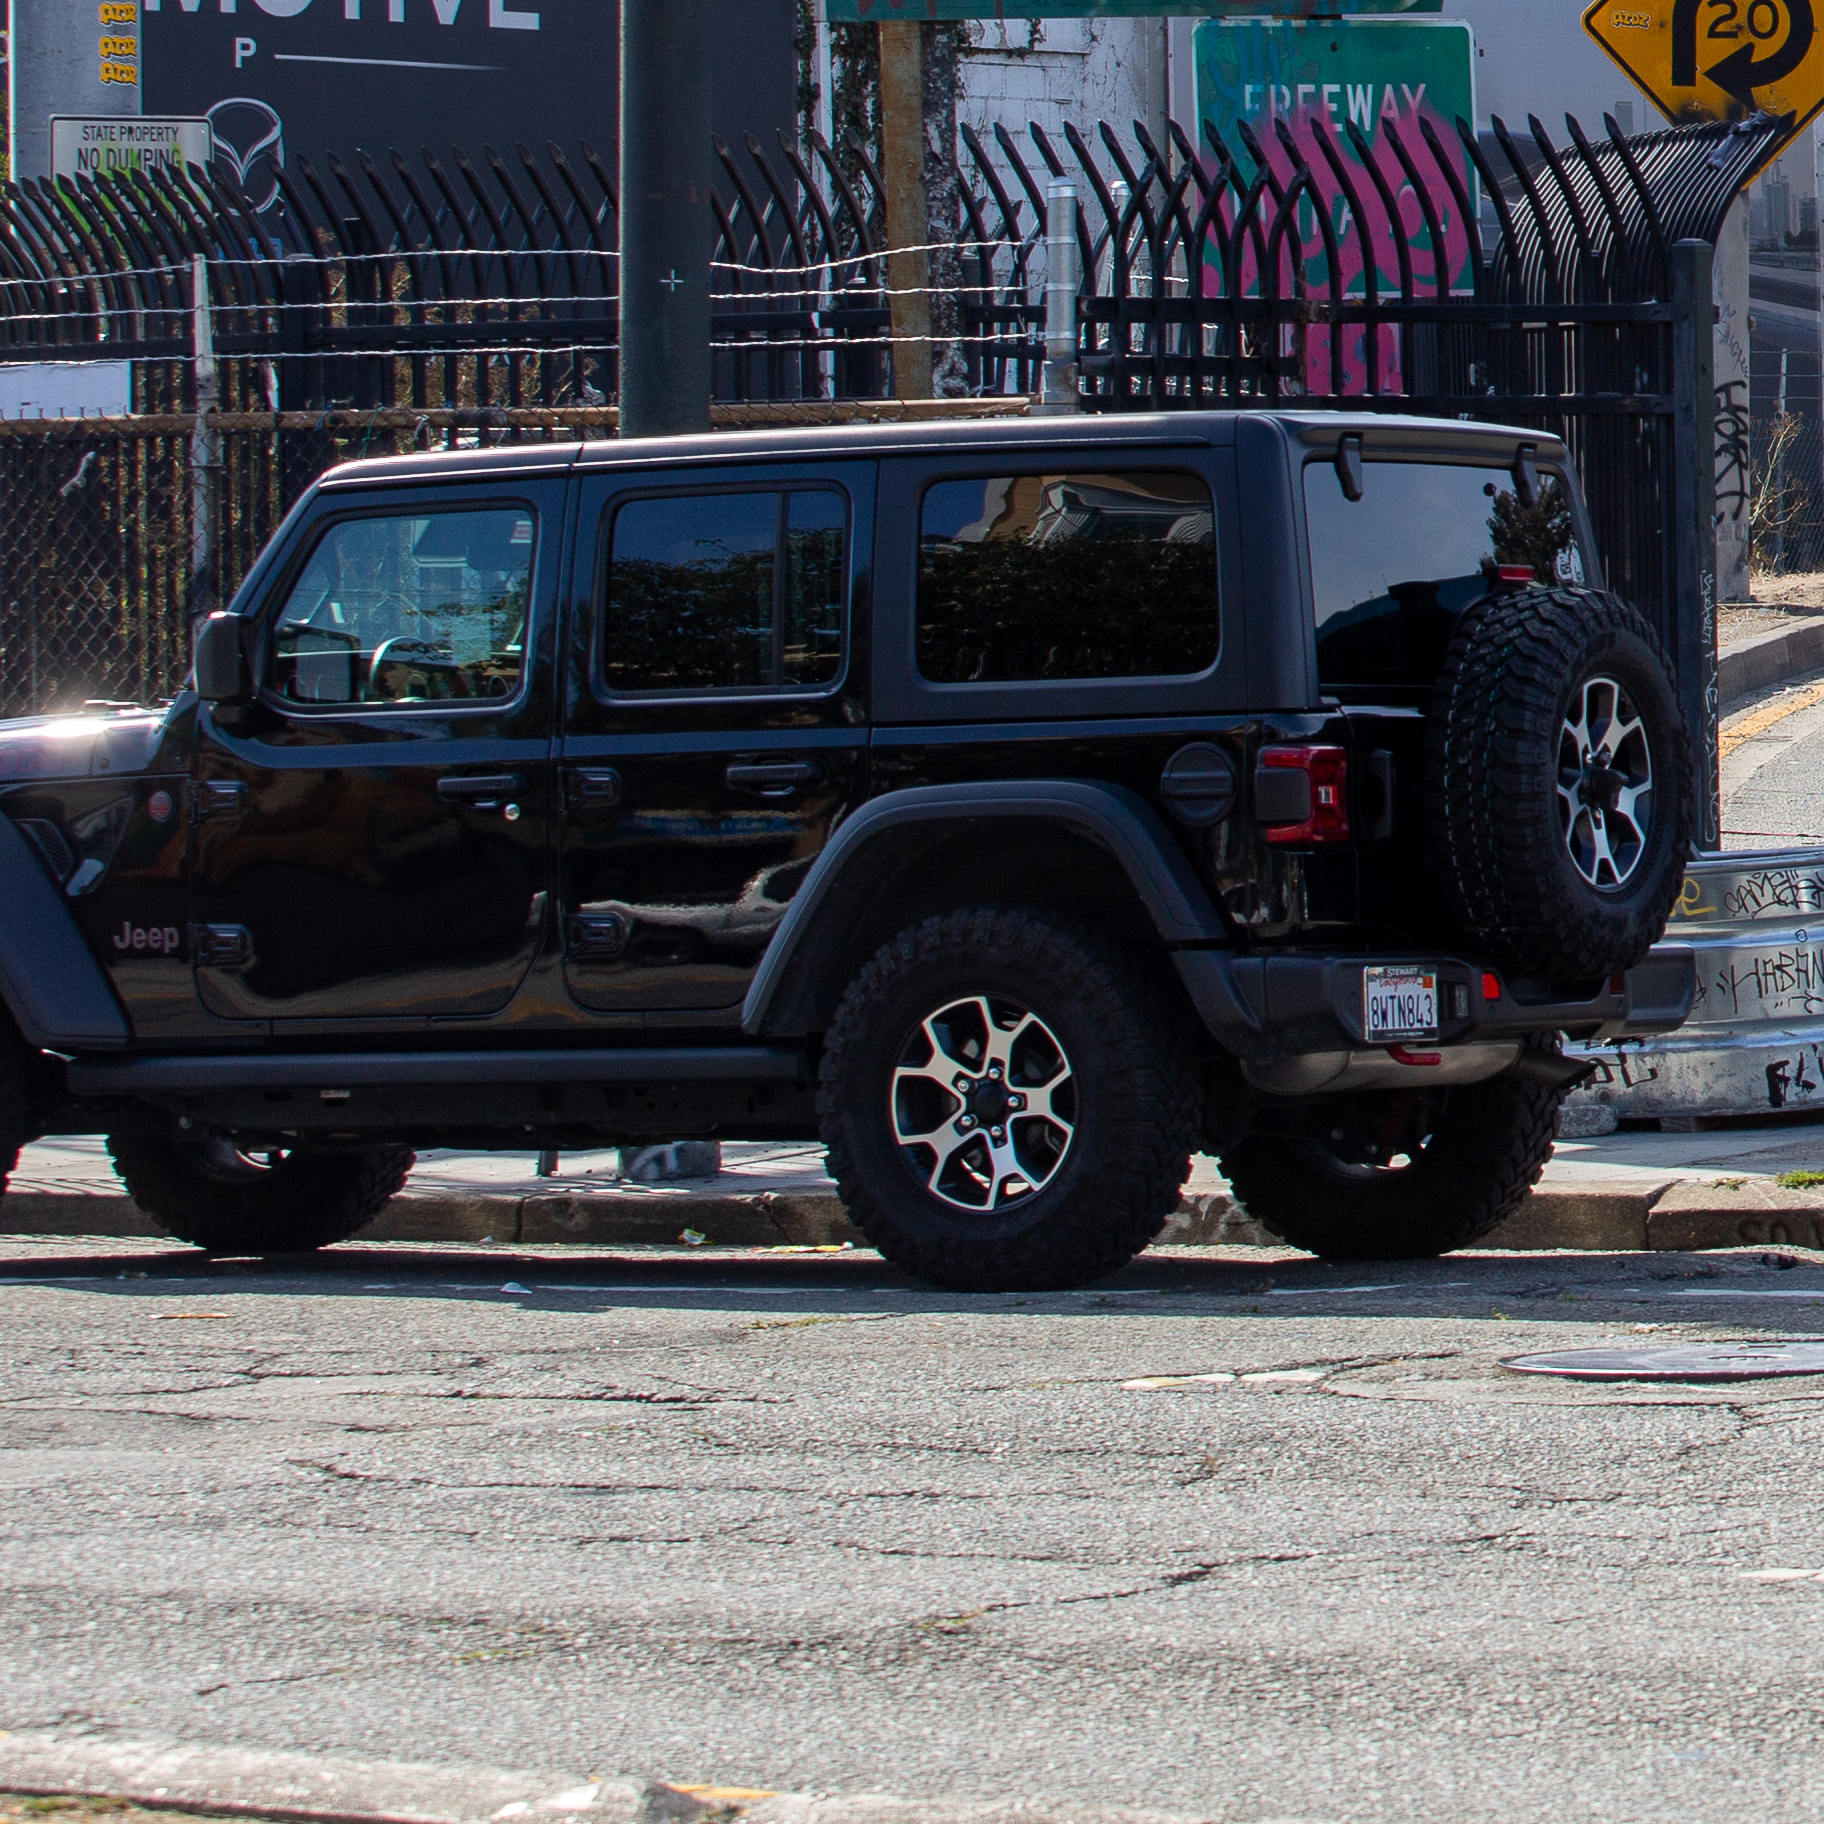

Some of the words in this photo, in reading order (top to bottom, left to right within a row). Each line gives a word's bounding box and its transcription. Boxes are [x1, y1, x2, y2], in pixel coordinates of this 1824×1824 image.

[235, 38, 257, 68] P
[1243, 83, 1427, 132] FREEWAY
[82, 125, 117, 142] STATE
[120, 126, 180, 143] PROPERTY
[77, 147, 100, 171] NO
[107, 148, 182, 172] DUMPING
[114, 921, 179, 951] Jeep
[1371, 993, 1433, 1029] 8WTN843
